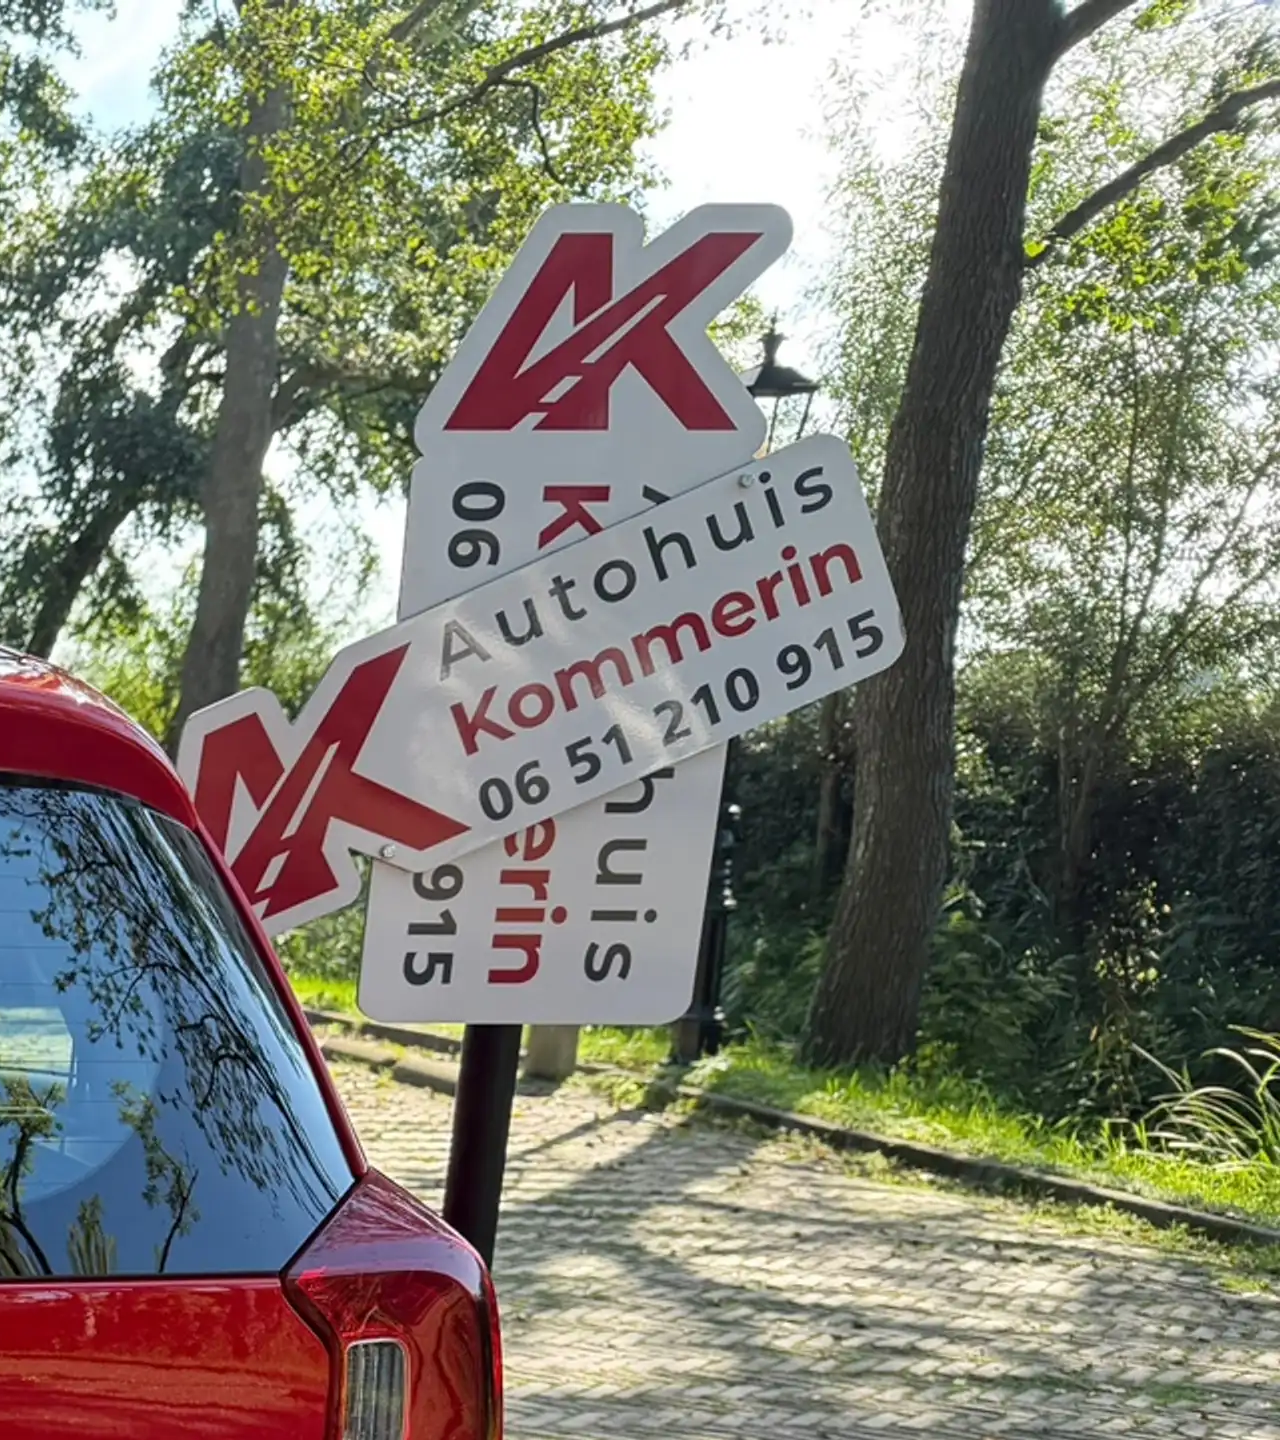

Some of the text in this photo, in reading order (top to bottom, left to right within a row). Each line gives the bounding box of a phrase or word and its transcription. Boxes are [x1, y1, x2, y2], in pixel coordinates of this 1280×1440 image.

[439, 466, 833, 682] Autohuis
[450, 541, 863, 756] Kommerin
[478, 609, 885, 821] 06 51 210 915
[402, 864, 464, 986] 915
